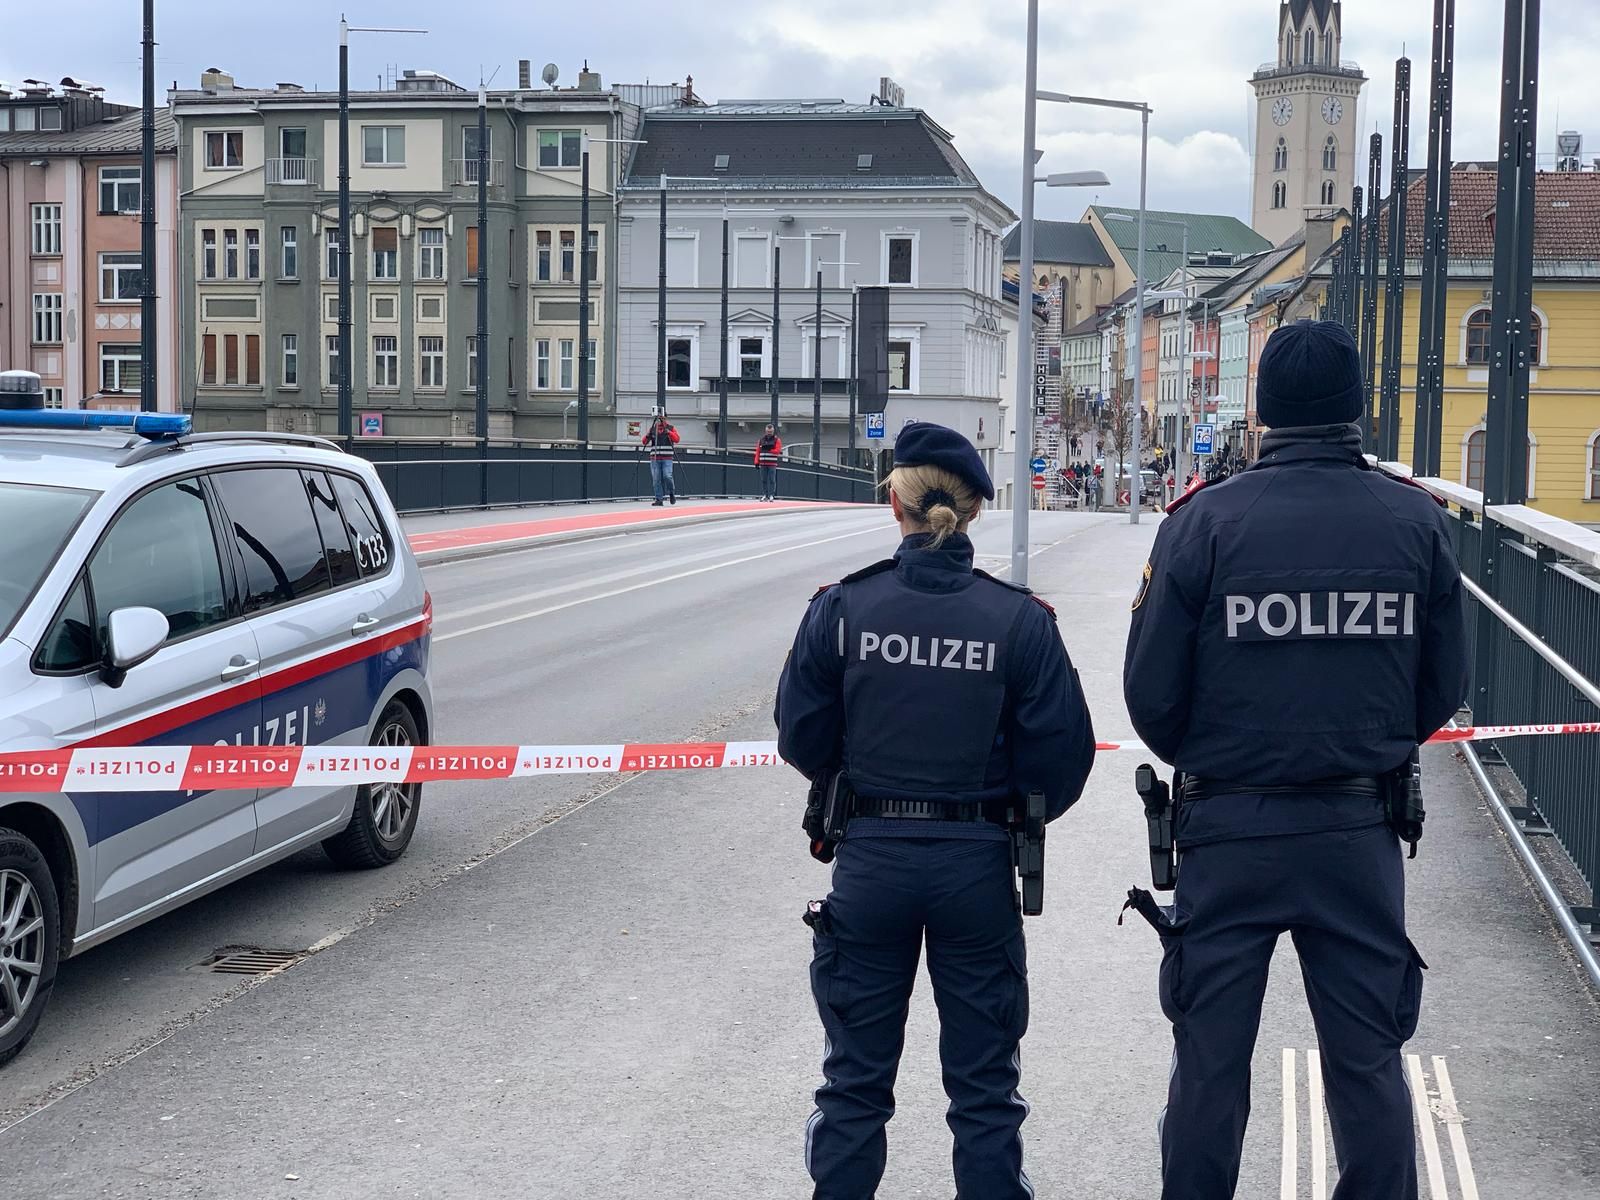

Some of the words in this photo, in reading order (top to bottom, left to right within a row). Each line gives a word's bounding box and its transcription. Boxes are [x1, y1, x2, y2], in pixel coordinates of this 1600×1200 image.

[1037, 365, 1045, 416] HOTEL
[364, 532, 387, 568] 133
[1226, 592, 1415, 638] POLIZEI
[859, 631, 996, 672] POLIZEI
[90, 760, 175, 775] POLIZEI
[207, 759, 289, 774] POLIZEI
[320, 757, 400, 772] POLIZEI
[430, 756, 507, 770] POLIZEI
[536, 756, 612, 769] POLIZEI
[640, 755, 714, 768] POLIZEI
